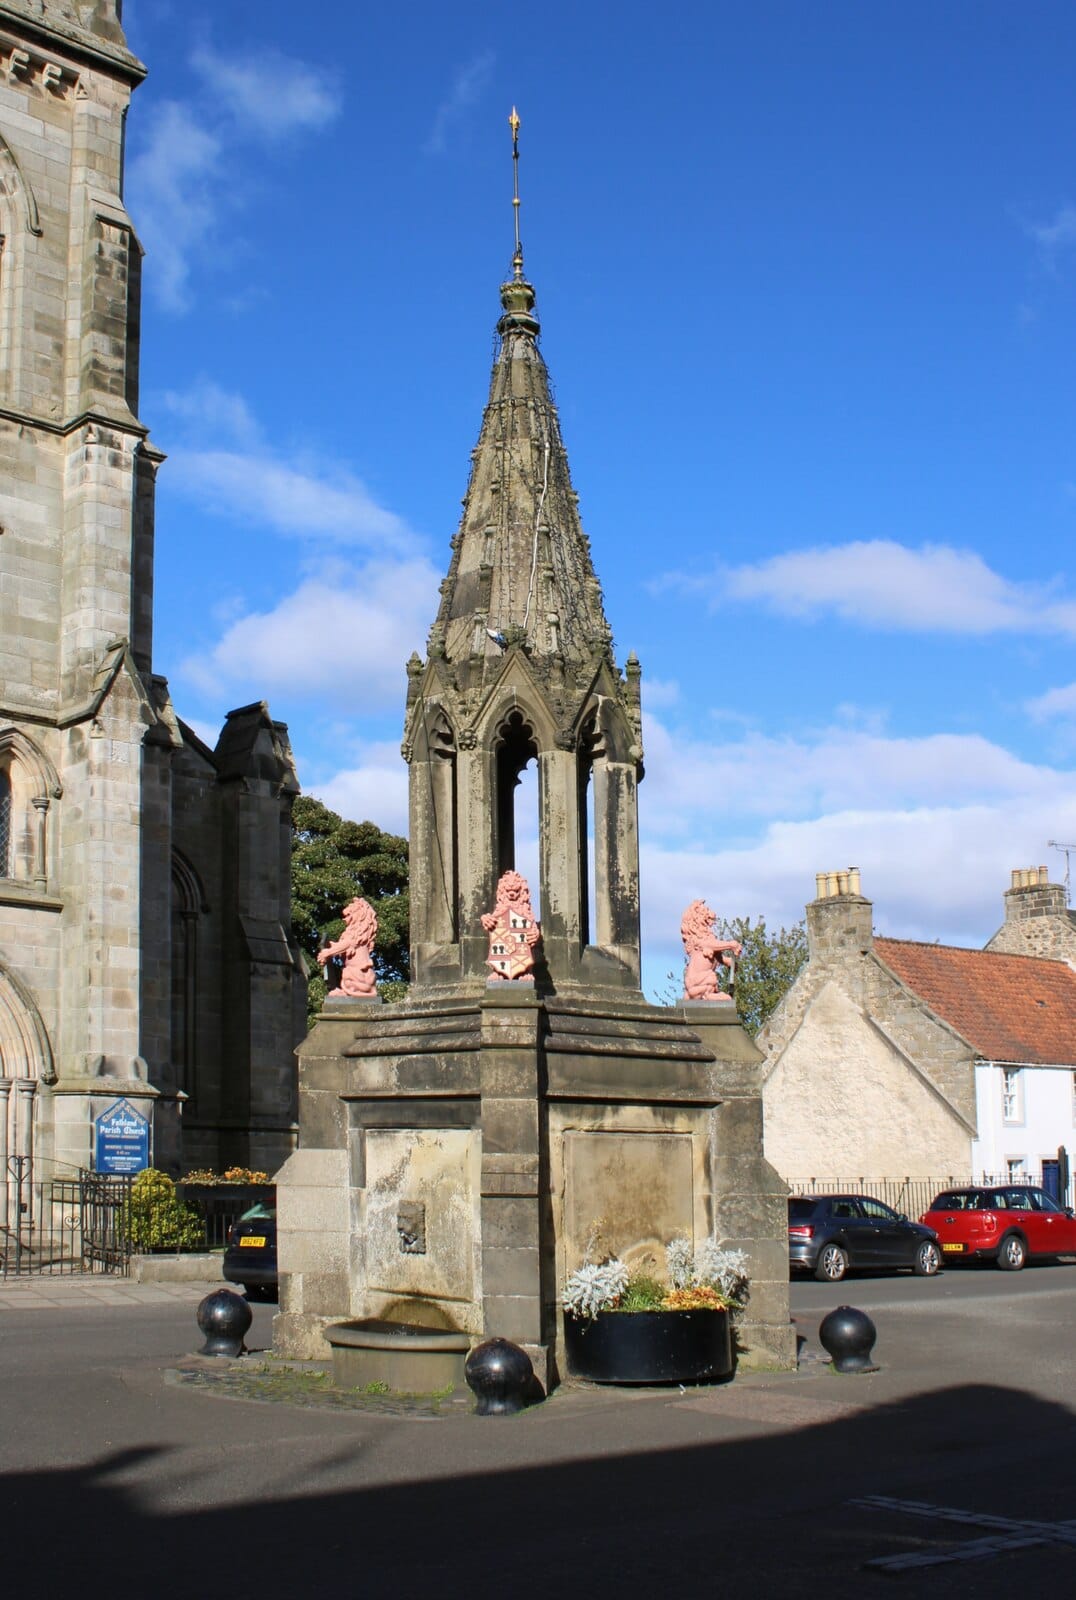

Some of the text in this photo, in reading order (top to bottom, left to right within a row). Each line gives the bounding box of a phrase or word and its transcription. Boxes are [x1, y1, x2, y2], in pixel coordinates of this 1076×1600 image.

[111, 1118, 137, 1127] Falkland
[100, 1125, 146, 1136] Parish Church
